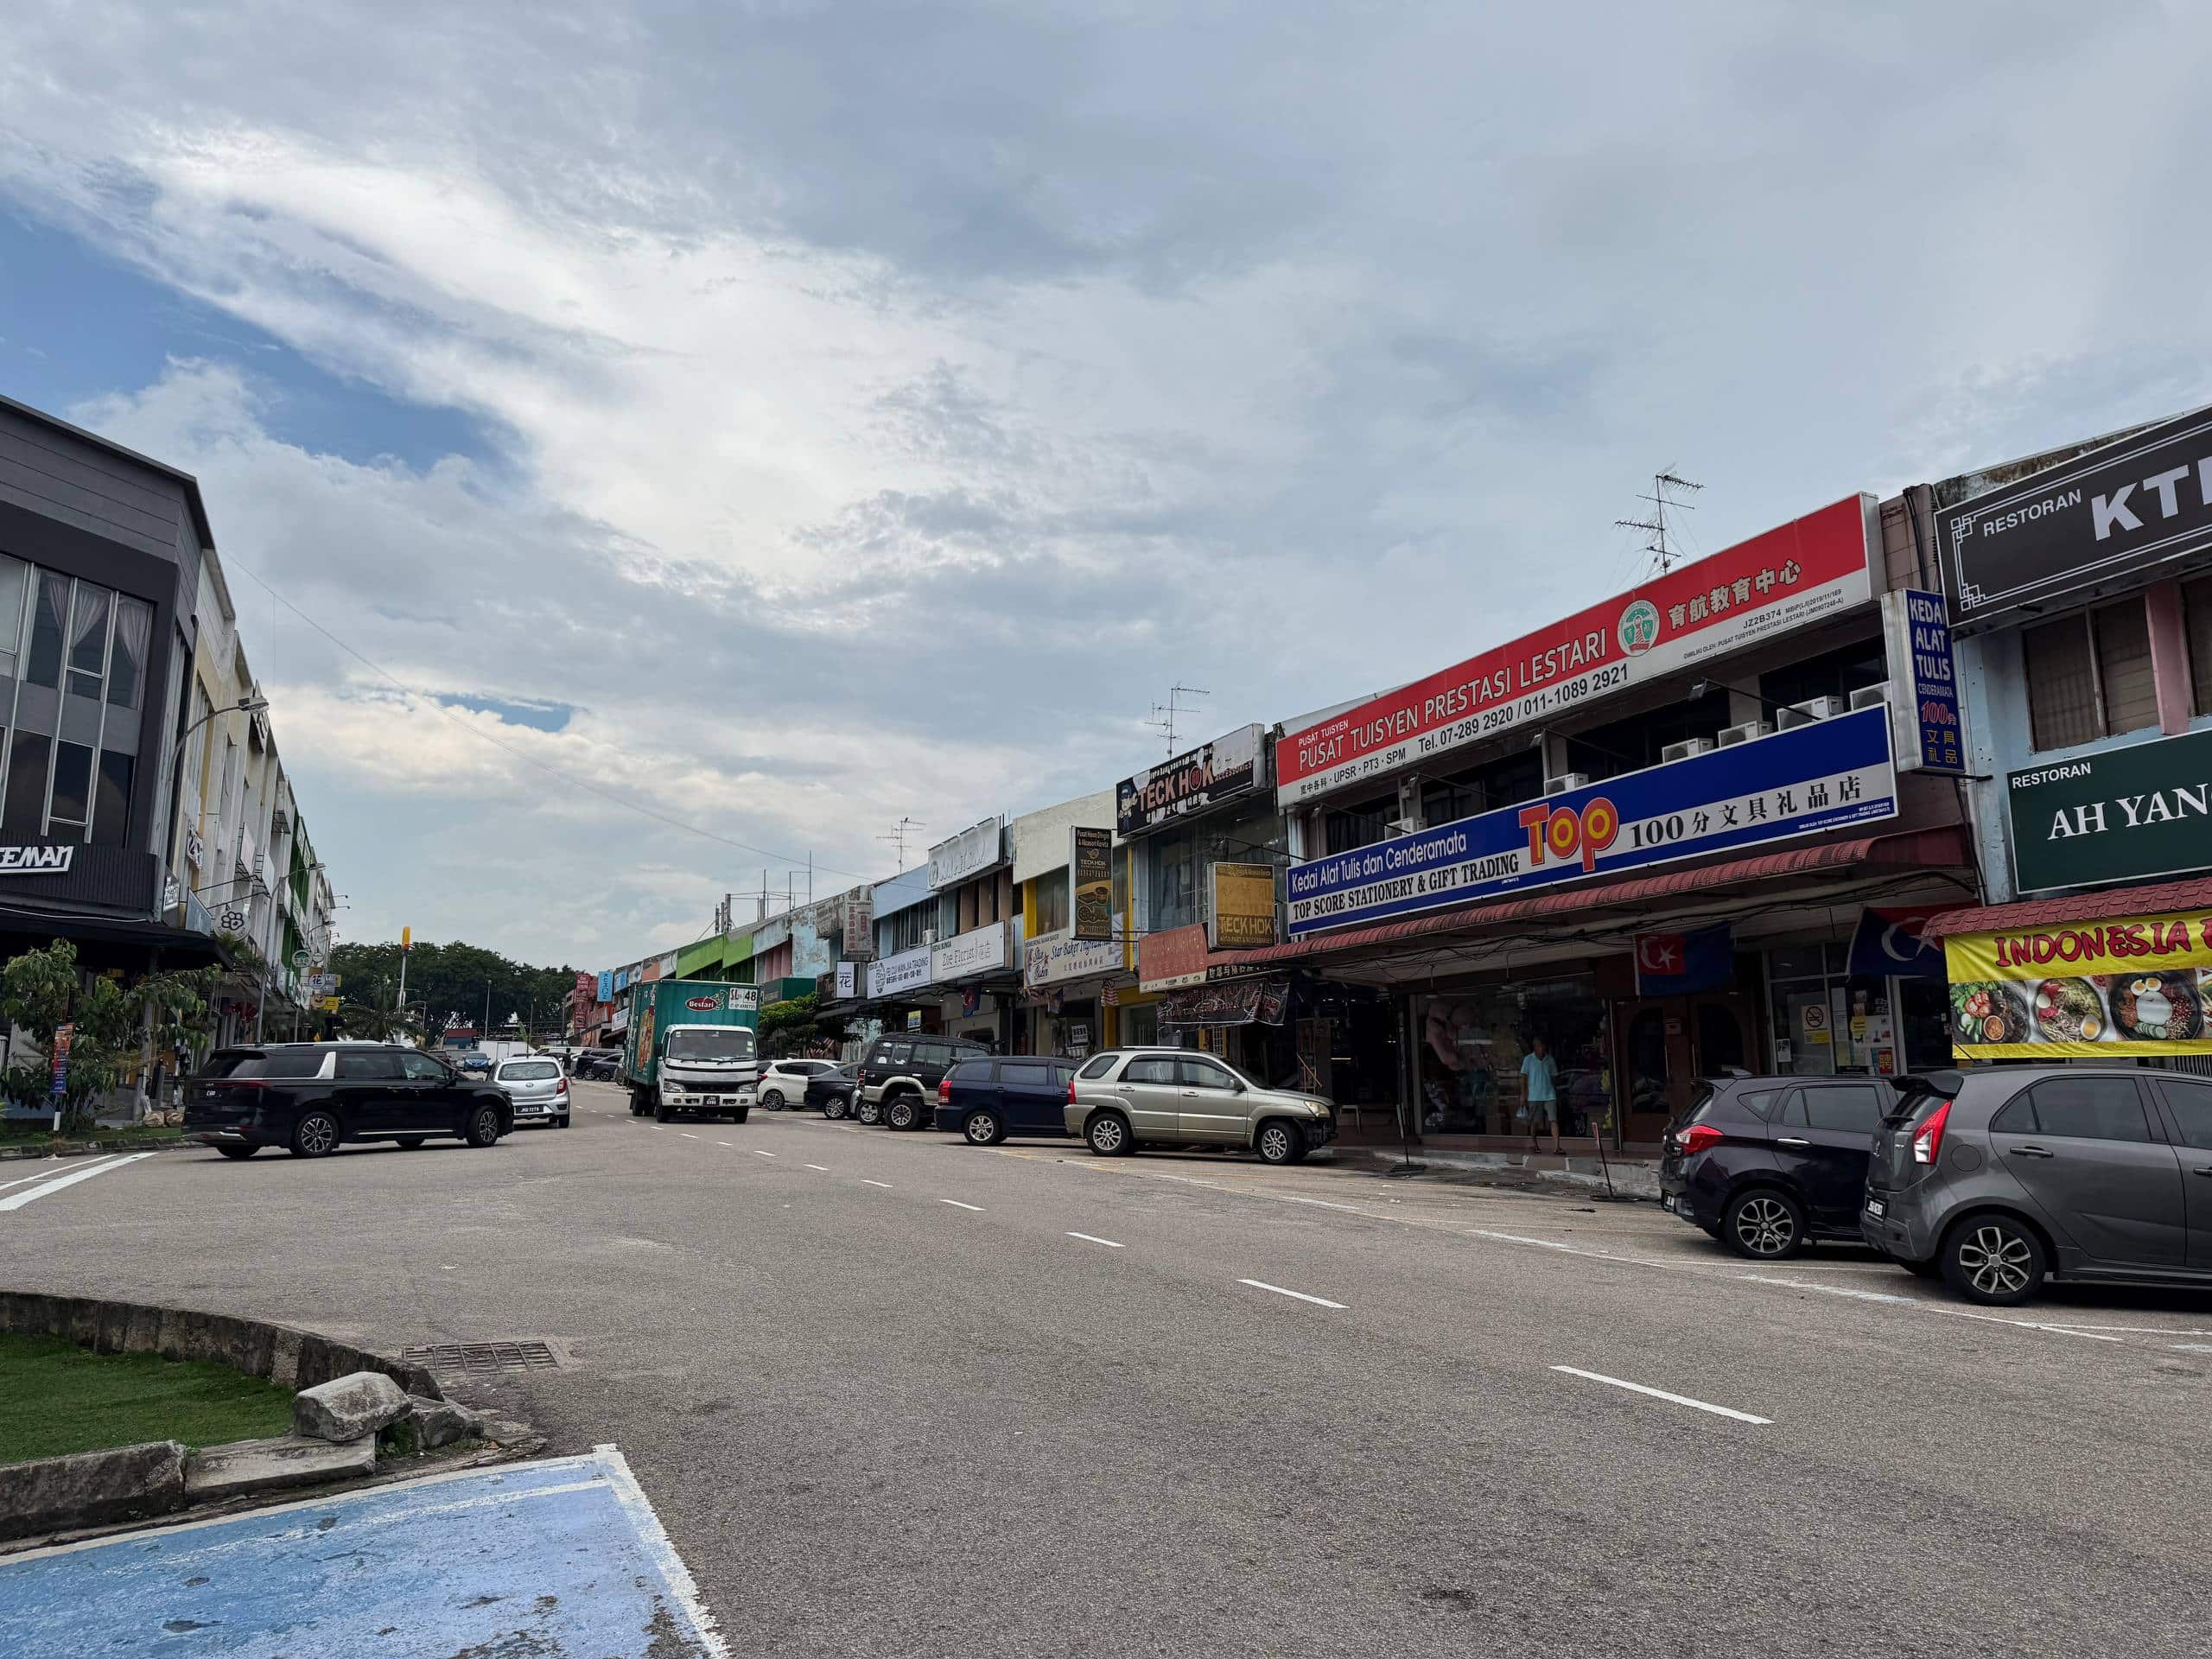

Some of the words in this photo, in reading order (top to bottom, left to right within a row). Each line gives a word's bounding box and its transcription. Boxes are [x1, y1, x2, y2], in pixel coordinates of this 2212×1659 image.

[1983, 488, 2082, 537] RESTORAN
[2091, 455, 2212, 541] KT
[1668, 558, 1802, 631] 育航教育中心
[1718, 636, 1733, 648] PUSAT
[1735, 629, 1757, 642] TUISYEN
[1757, 620, 1782, 634] PRESTASI
[1783, 611, 1805, 625] LESTARI
[1743, 608, 1782, 629] JZ2B374
[1916, 626, 1945, 652] ALAT
[1916, 654, 1951, 681] TULIS
[1299, 734, 1344, 772] PUSAT
[1351, 704, 1418, 752] TUISYEN
[1425, 665, 1511, 724] PRESTASI
[1520, 627, 1606, 688] LESTARI
[1419, 737, 1438, 753] Tel.
[1440, 718, 1479, 746] 07-289
[1484, 705, 1512, 729] 2920
[1524, 677, 1588, 715] 011-1089
[1592, 663, 1628, 692] 2921
[1918, 683, 1954, 698] CENDERAMATA
[1299, 732, 1319, 747] PUSAT
[1321, 719, 1349, 737] TUISYEN
[1334, 766, 1357, 784] UPSR
[1363, 757, 1379, 773] PT3
[1386, 747, 1406, 765] SPM
[2012, 761, 2091, 789] RESTORAN
[1139, 774, 1176, 811] TECK
[2047, 802, 2108, 841] AH
[2115, 783, 2212, 829] YAN
[1292, 868, 1318, 893] Kedai
[1319, 864, 1340, 887] Alat
[1341, 858, 1361, 881] Tulis
[1363, 855, 1382, 875] dan
[1385, 830, 1467, 870] Cenderamata
[1293, 903, 1312, 920] TOP
[1313, 894, 1345, 915] SCORE
[1348, 876, 1414, 907] STATIONERY
[1417, 875, 1426, 893] &
[1429, 864, 1458, 891] GIFT
[1460, 853, 1520, 881] TRADING
[1217, 916, 1248, 934] TECK
[1249, 917, 1273, 935] HOK
[1995, 920, 2192, 968] INDONESIA
[744, 990, 757, 1001] 48
[839, 976, 852, 988] 花
